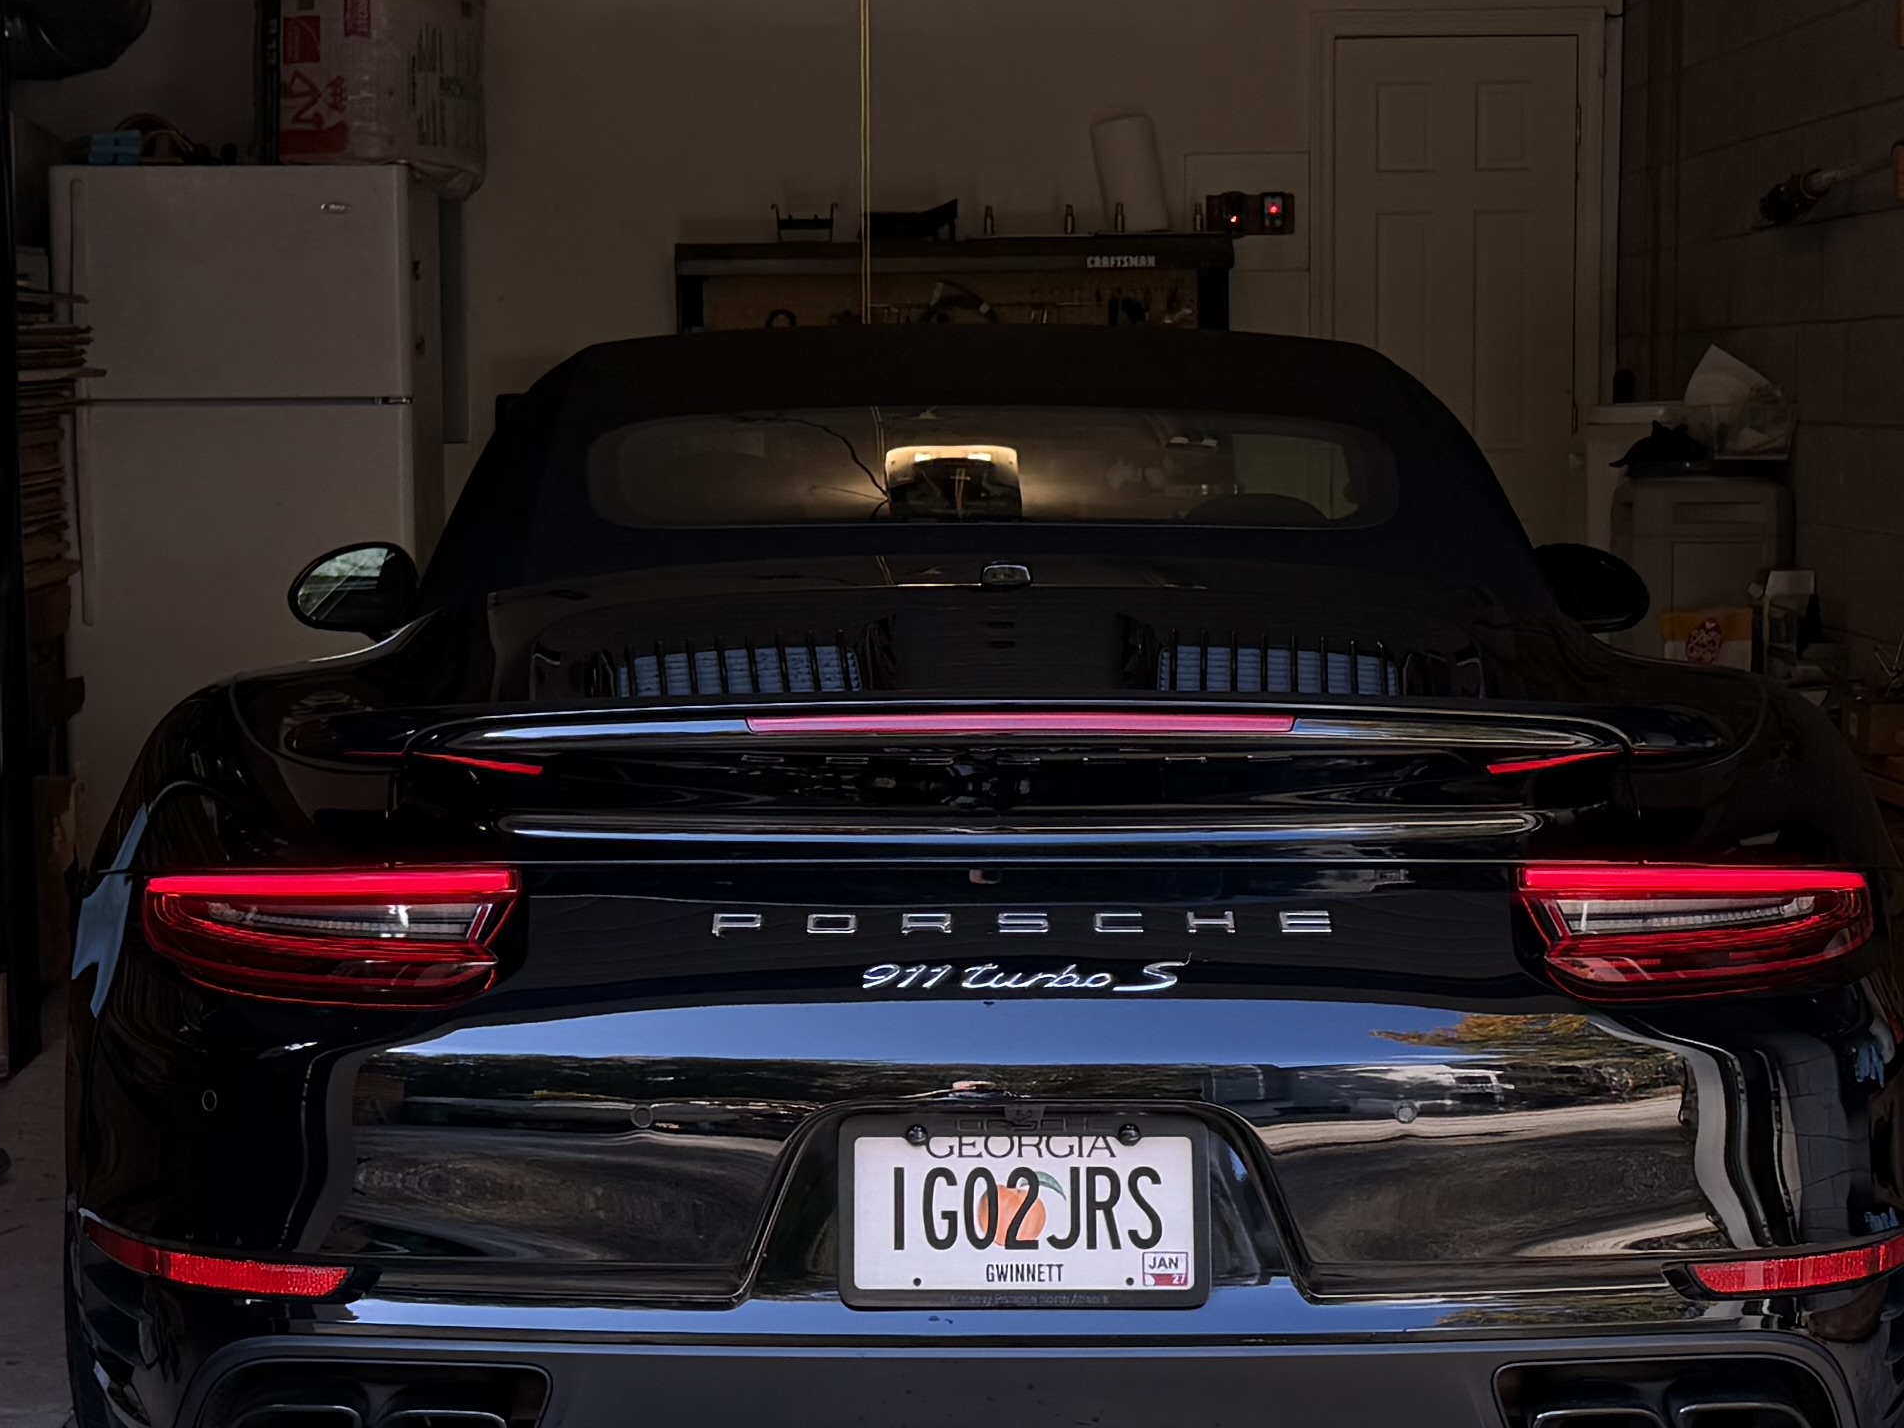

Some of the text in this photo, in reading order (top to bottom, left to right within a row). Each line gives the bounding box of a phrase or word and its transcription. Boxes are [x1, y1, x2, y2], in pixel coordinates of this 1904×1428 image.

[1086, 255, 1157, 269] CRAFTSMAN
[712, 912, 1333, 936] PORSCHE
[862, 958, 1188, 992] 911 turbo S
[926, 1135, 1117, 1159] GEORGIA
[985, 1263, 1065, 1283] GWINNETT
[1148, 1256, 1179, 1270] JAN
[1171, 1274, 1186, 1285] 27
